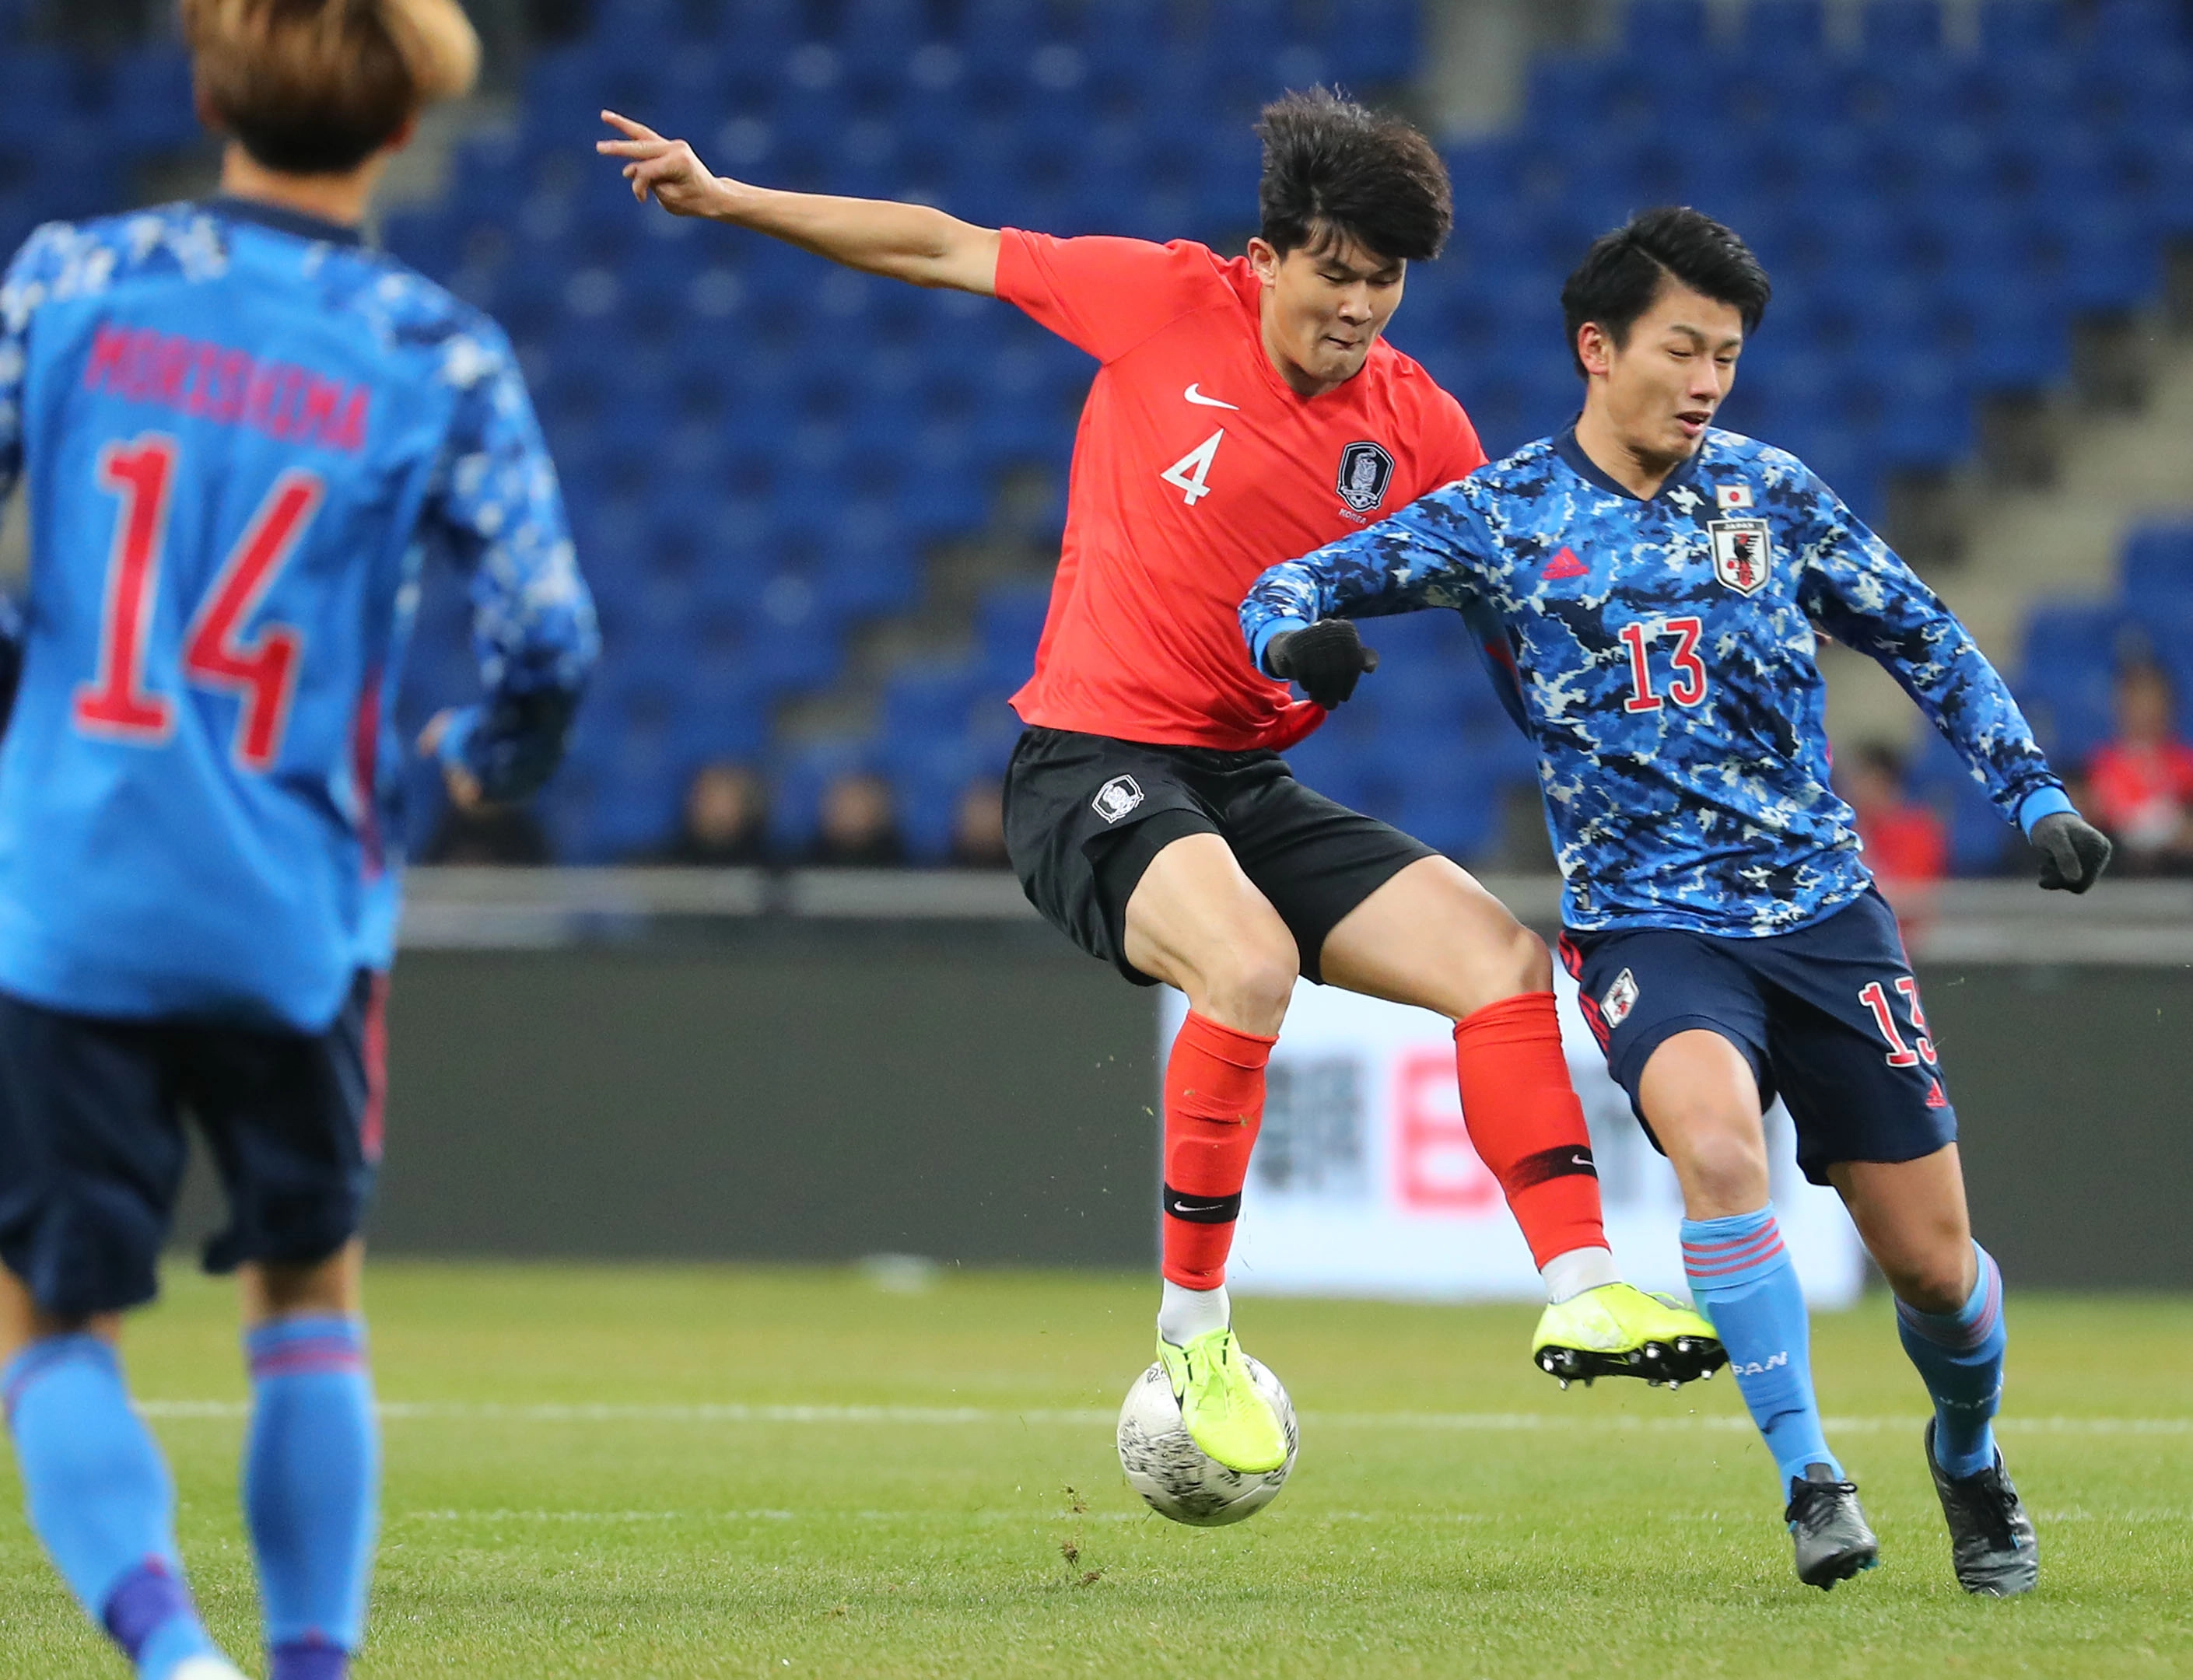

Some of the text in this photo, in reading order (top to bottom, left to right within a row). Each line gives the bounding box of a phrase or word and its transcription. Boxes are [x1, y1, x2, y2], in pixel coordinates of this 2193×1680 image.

[1159, 428, 1224, 506] 4
[1338, 508, 1367, 524] KOREA
[72, 430, 325, 771] 14
[1618, 616, 1708, 713] 13
